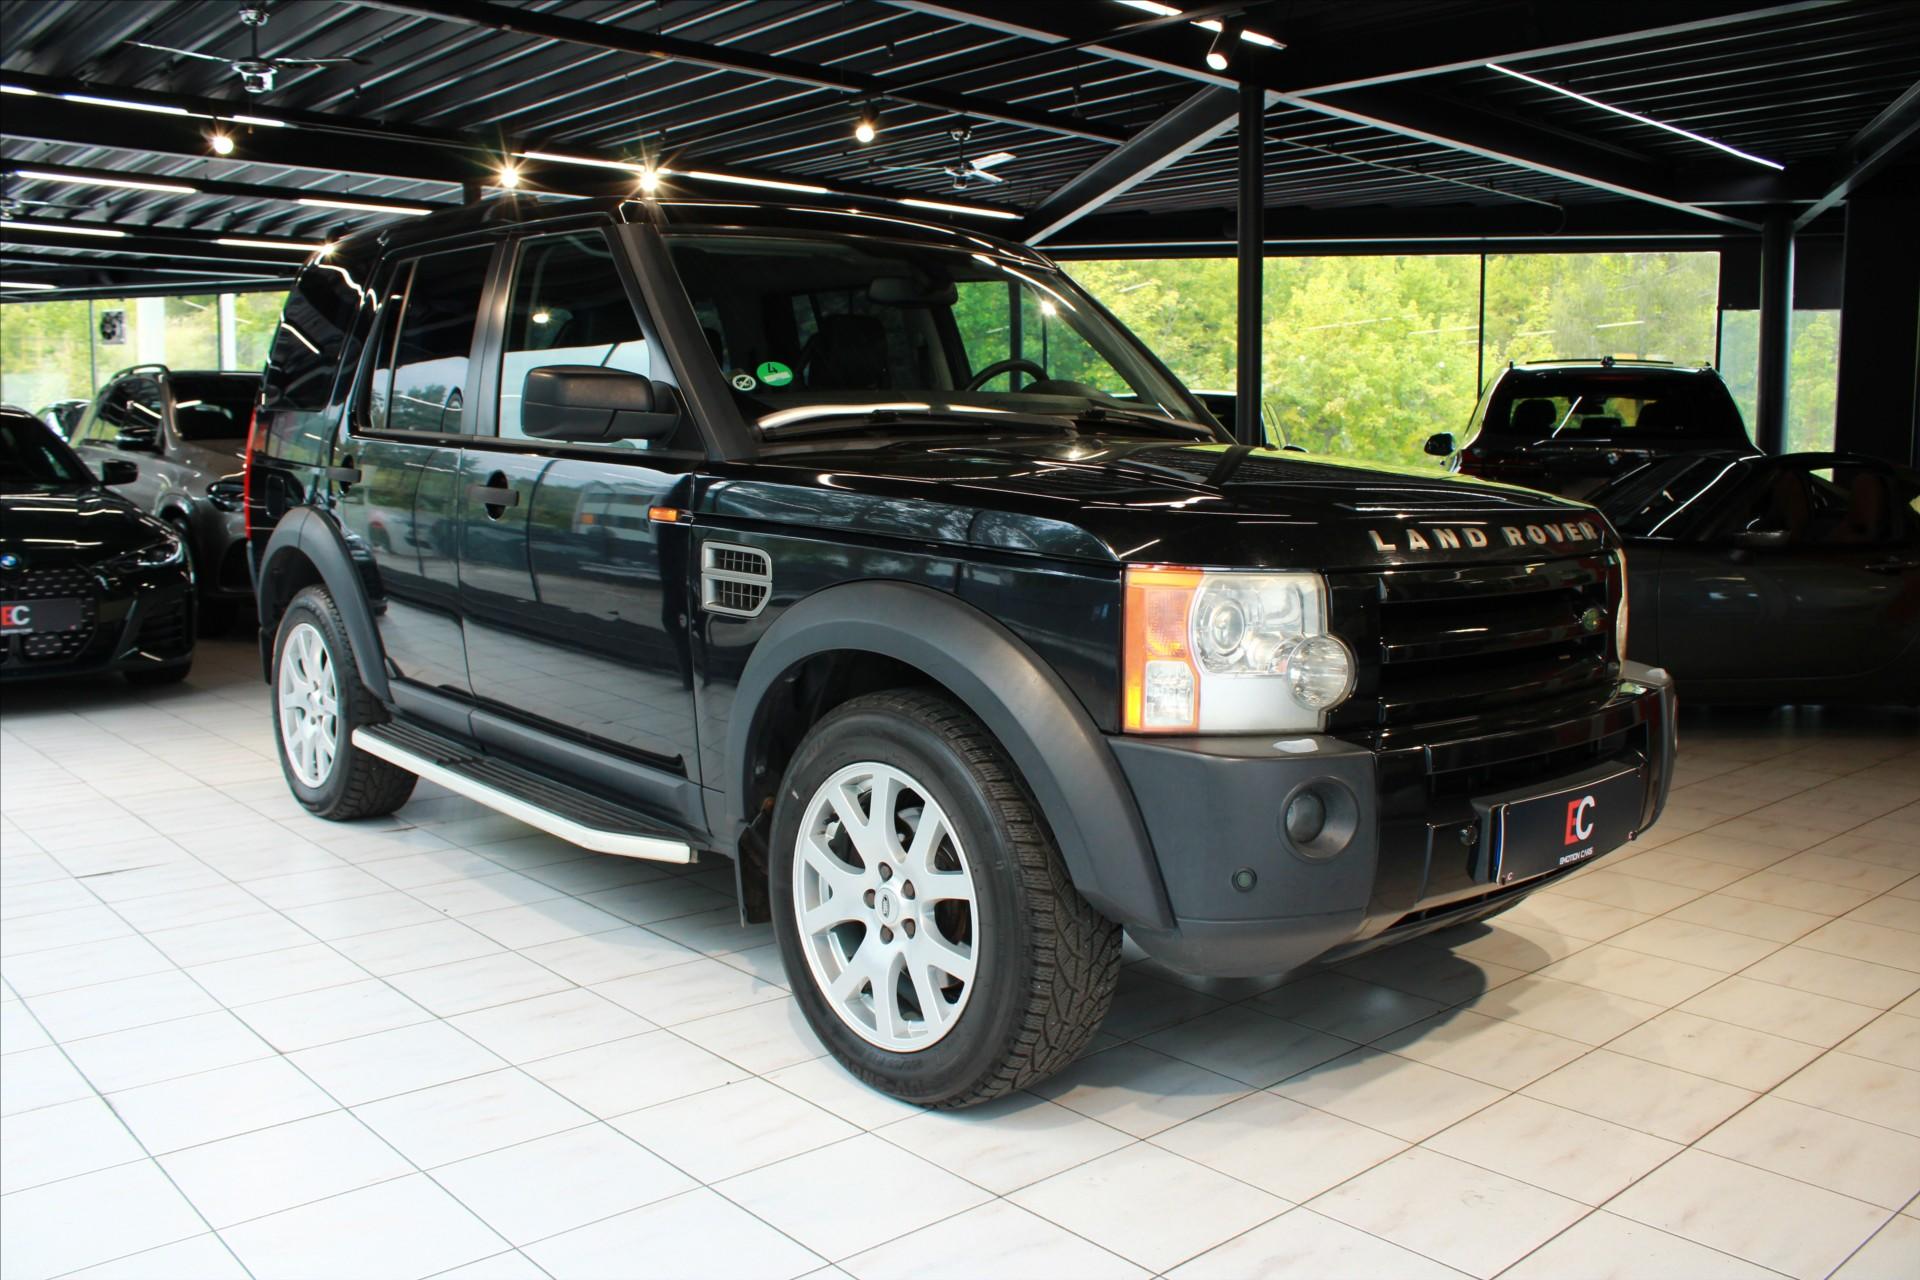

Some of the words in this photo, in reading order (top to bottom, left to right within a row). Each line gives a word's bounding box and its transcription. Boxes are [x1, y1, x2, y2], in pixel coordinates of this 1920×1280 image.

[1368, 527, 1488, 551] LAND
[1501, 521, 1598, 546] ROVER
[1, 605, 30, 625] EC
[1564, 795, 1596, 846] EC
